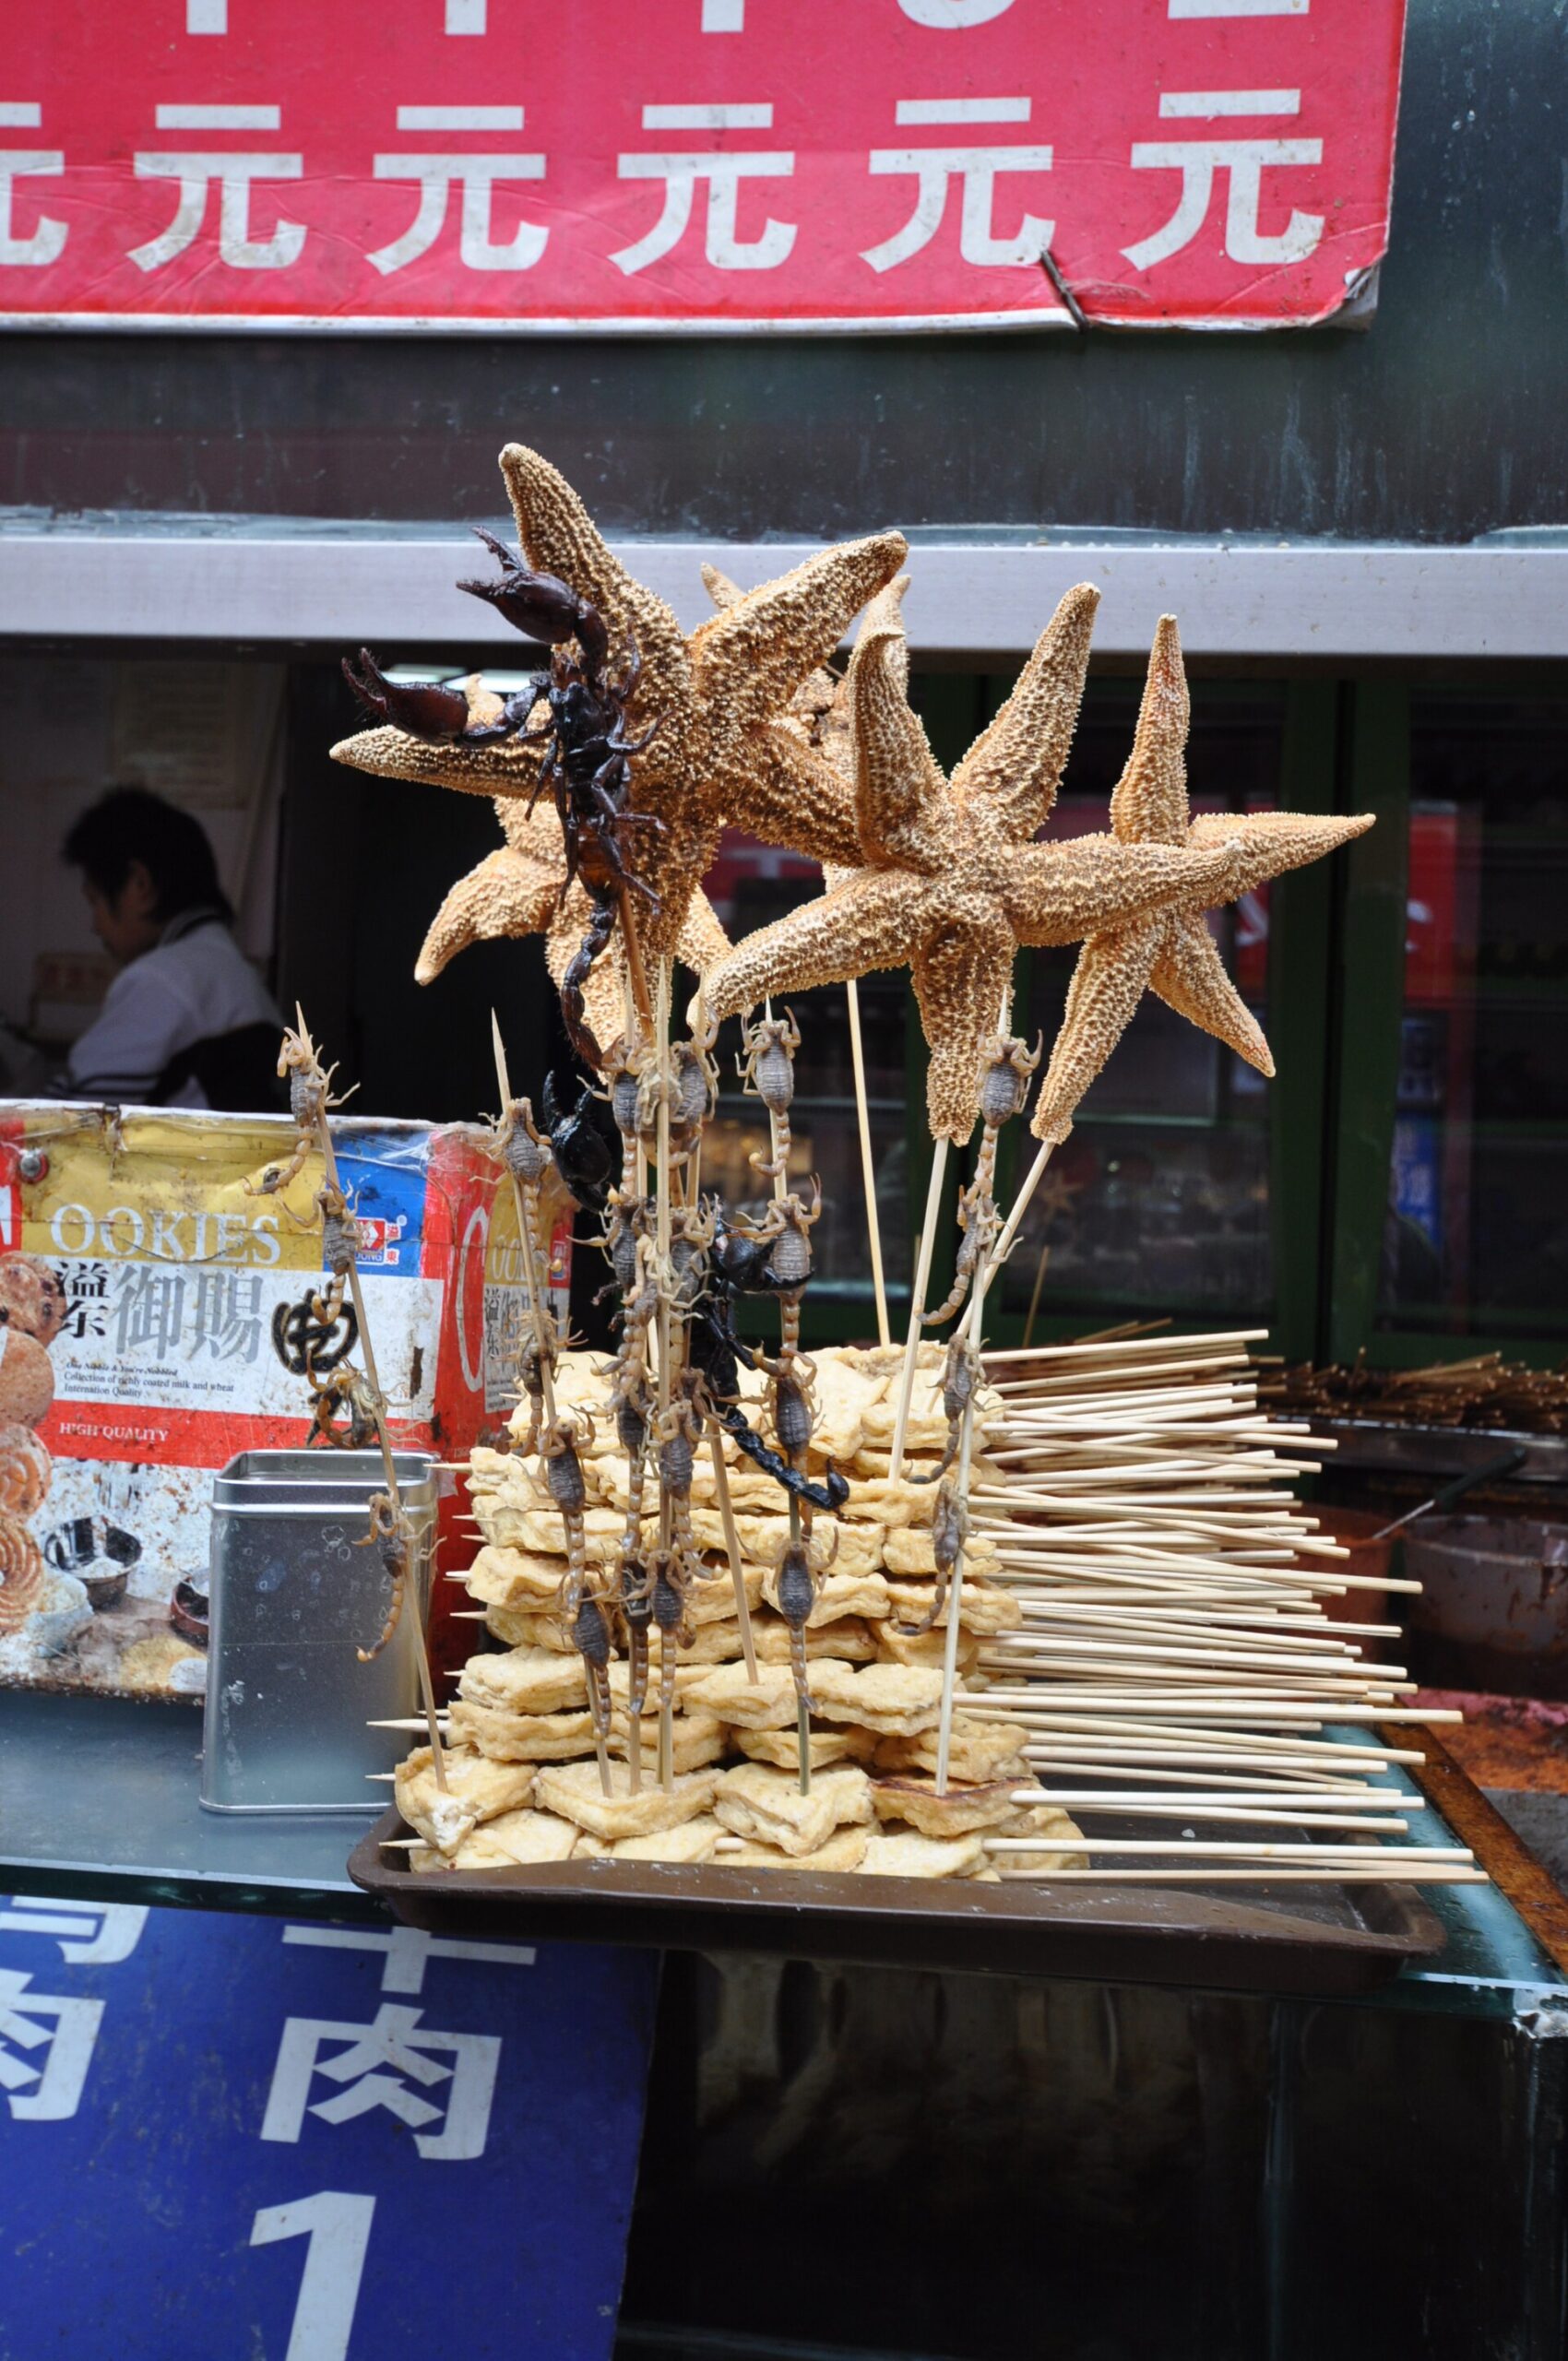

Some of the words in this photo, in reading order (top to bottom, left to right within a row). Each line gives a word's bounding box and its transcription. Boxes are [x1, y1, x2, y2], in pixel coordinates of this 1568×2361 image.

[126, 104, 307, 272] 元
[365, 106, 550, 276] 元
[608, 103, 798, 276] 元
[859, 97, 1056, 273] 元
[1119, 89, 1325, 271] 元
[59, 1422, 99, 1437] HIGH
[102, 1425, 169, 1442] QUALITY
[64, 1372, 106, 1383] Collection
[107, 1374, 116, 1383] of
[192, 1382, 208, 1390] and
[112, 1385, 143, 1398] Quality
[249, 2190, 376, 2361] 1
